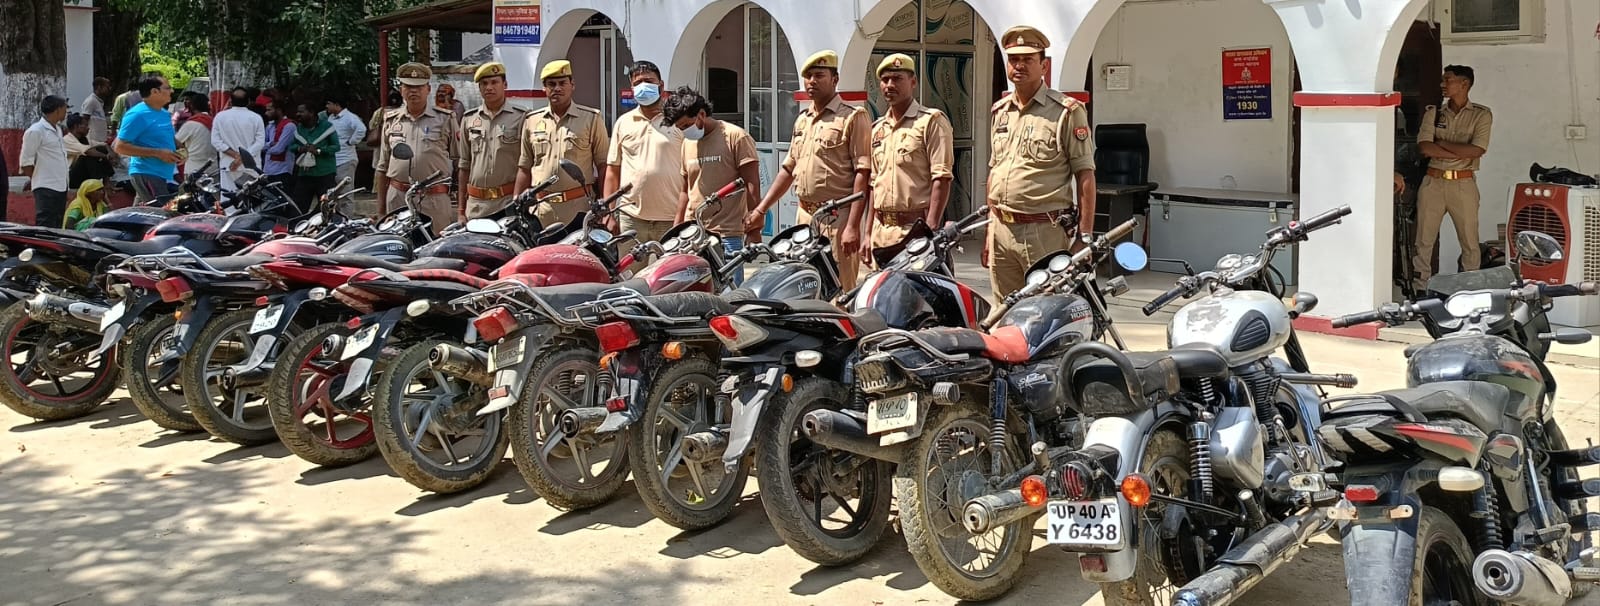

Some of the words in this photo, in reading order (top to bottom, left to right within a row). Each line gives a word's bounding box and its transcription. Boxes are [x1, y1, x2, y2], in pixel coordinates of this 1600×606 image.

[1237, 101, 1258, 110] 1930
[1056, 504, 1076, 519] UP
[1079, 504, 1097, 519] 40
[1101, 504, 1112, 519] A
[1051, 523, 1065, 540] Y
[1068, 523, 1118, 541] 6438
